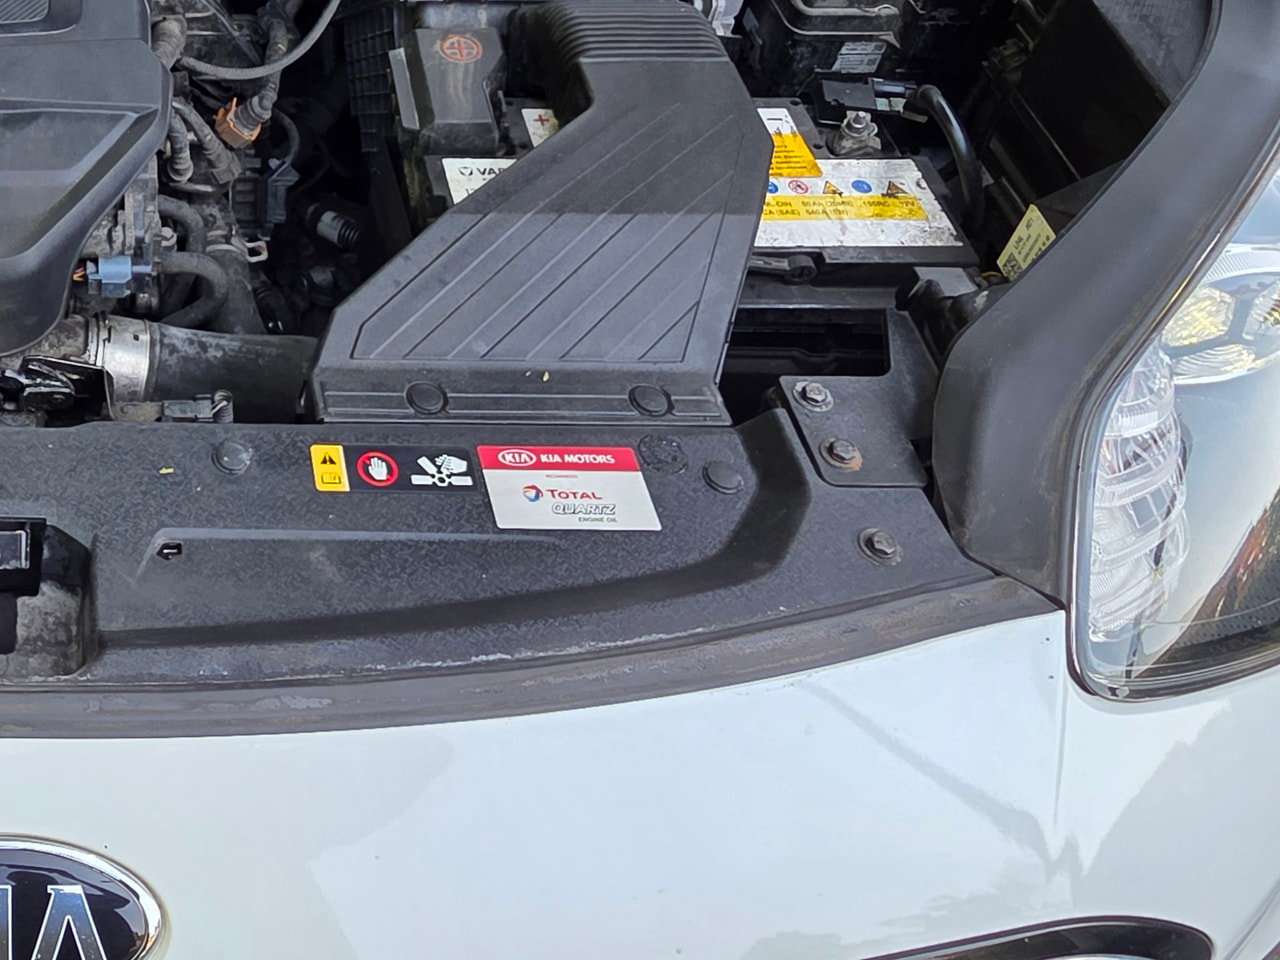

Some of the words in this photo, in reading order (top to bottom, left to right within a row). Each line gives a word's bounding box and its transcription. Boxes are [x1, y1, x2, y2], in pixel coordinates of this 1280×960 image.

[503, 452, 531, 464] KIA
[539, 453, 561, 464] KIA
[563, 453, 616, 464] MOTORS
[545, 488, 603, 501] TOTAL
[551, 502, 617, 516] QUARTZ
